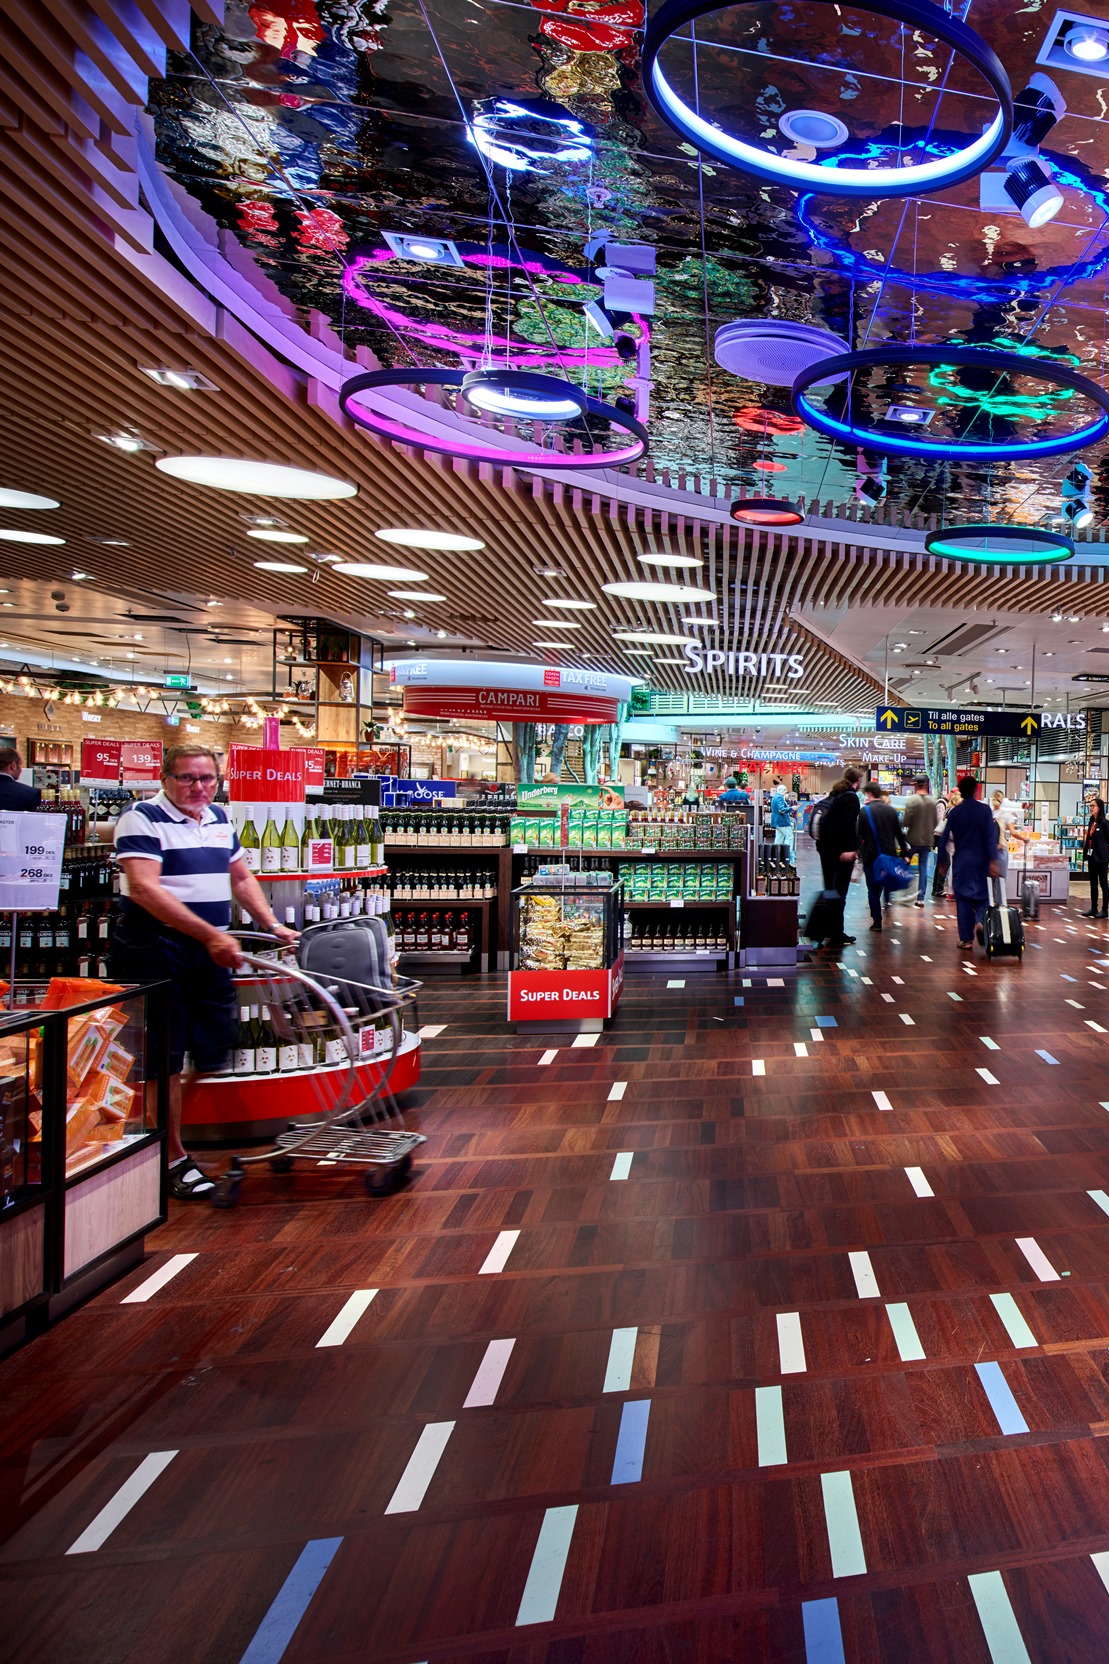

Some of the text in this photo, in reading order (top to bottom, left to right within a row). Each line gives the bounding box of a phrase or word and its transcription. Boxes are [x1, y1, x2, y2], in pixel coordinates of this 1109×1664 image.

[684, 642, 804, 678] SPIRITS
[562, 671, 607, 687] TAX FREE
[479, 691, 540, 707] CAMPARI
[928, 711, 985, 723] Til alle gates
[928, 721, 979, 732] To all gates
[838, 733, 907, 750] SKIN CARE
[96, 752, 110, 762] 95
[131, 754, 151, 763] 139
[740, 748, 801, 761] CHAMPAGNE
[862, 752, 907, 764] MAKE-UP
[738, 760, 809, 775] PAY HERE
[230, 767, 302, 782] SUPER DEALS
[324, 780, 362, 789] ERNET-BRANCA
[521, 786, 559, 801] Underberg
[24, 845, 45, 855] 199
[20, 868, 43, 878] 268
[520, 988, 600, 1002] SUPER DEALS
